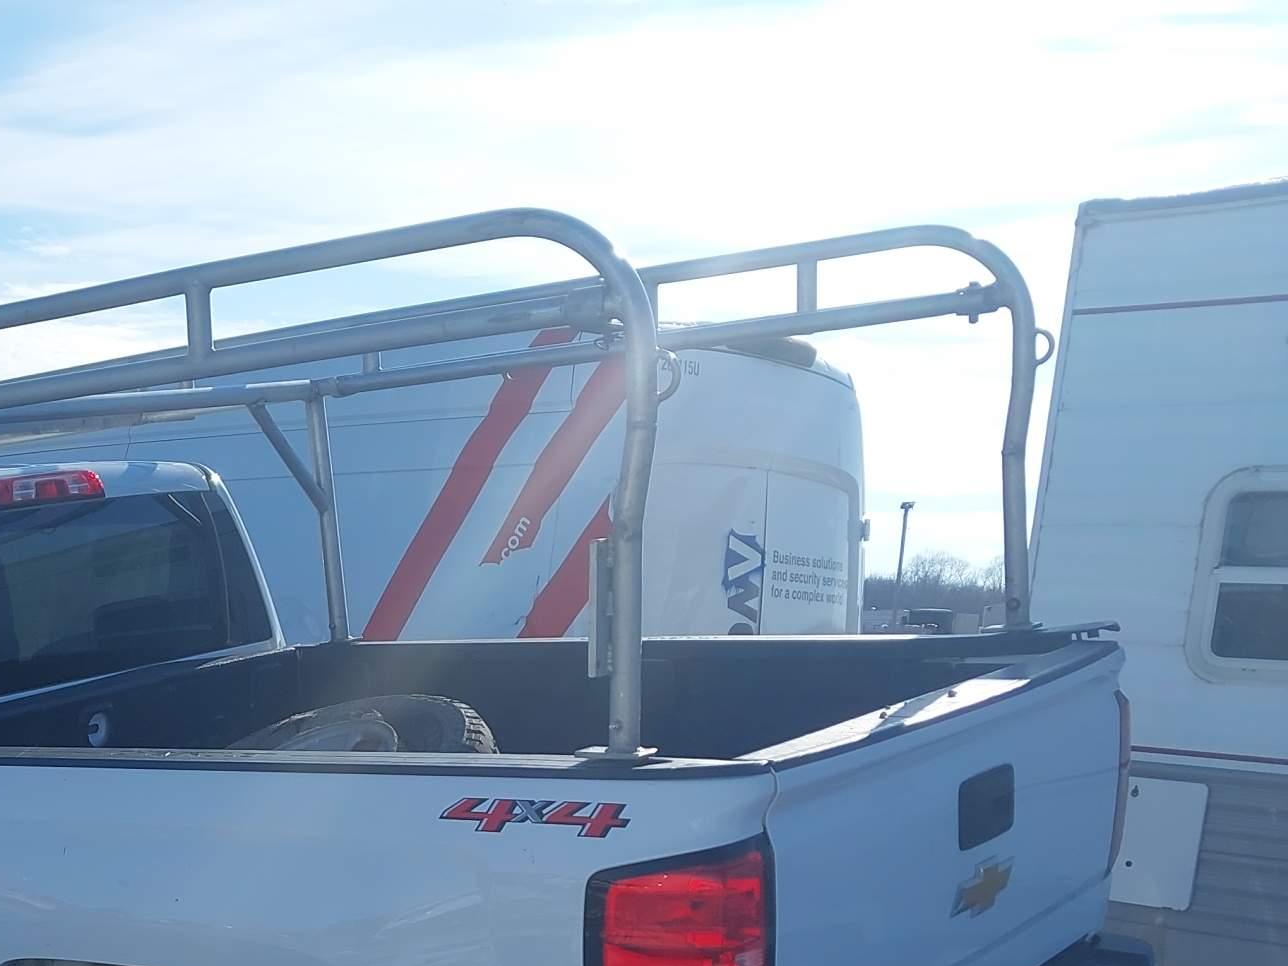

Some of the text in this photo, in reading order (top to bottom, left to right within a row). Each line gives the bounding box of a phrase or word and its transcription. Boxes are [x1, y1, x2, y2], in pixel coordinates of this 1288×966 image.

[773, 549, 810, 568] Business
[772, 569, 788, 582] and
[789, 571, 821, 588] security
[771, 584, 783, 599] for
[792, 589, 825, 605] complex
